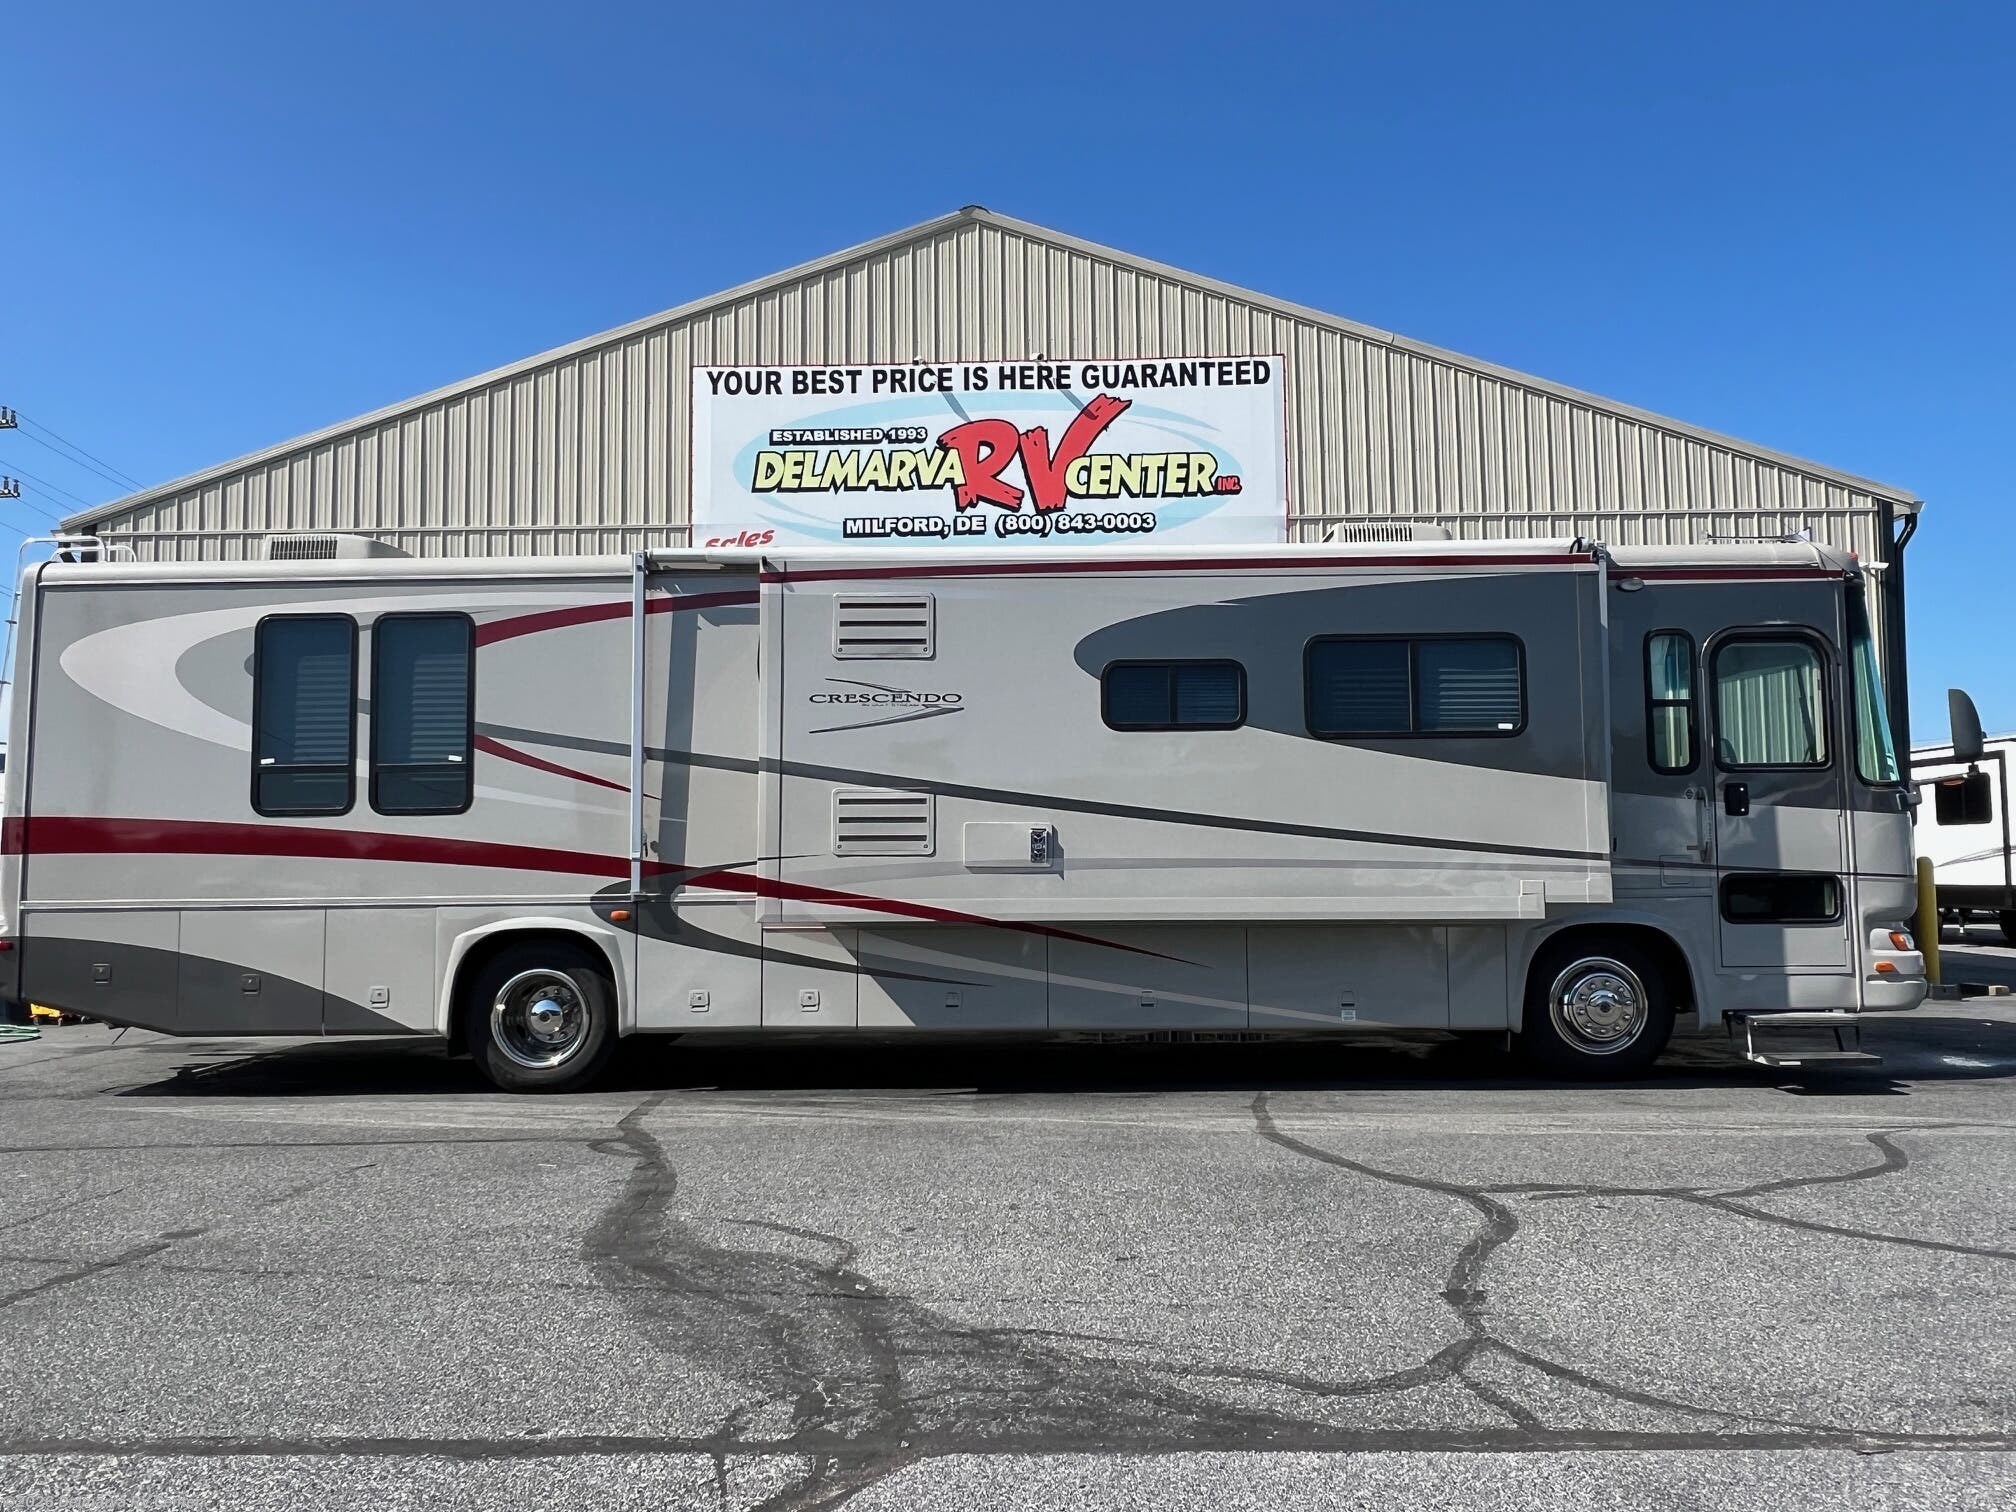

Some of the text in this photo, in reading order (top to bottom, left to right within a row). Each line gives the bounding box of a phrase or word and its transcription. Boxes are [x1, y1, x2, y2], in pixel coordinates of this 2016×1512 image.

[707, 360, 1271, 396] YOUR BEST PRICE IS HERE GUARANTEED
[771, 427, 928, 443] ESTABLISHED 1993
[752, 449, 967, 493] DELMARVA
[936, 393, 1132, 512] RV
[1065, 453, 1219, 498] CENTER
[844, 513, 1156, 537] MILFORD, DE (800) 843-0003
[808, 693, 963, 703] CRESCENDO
